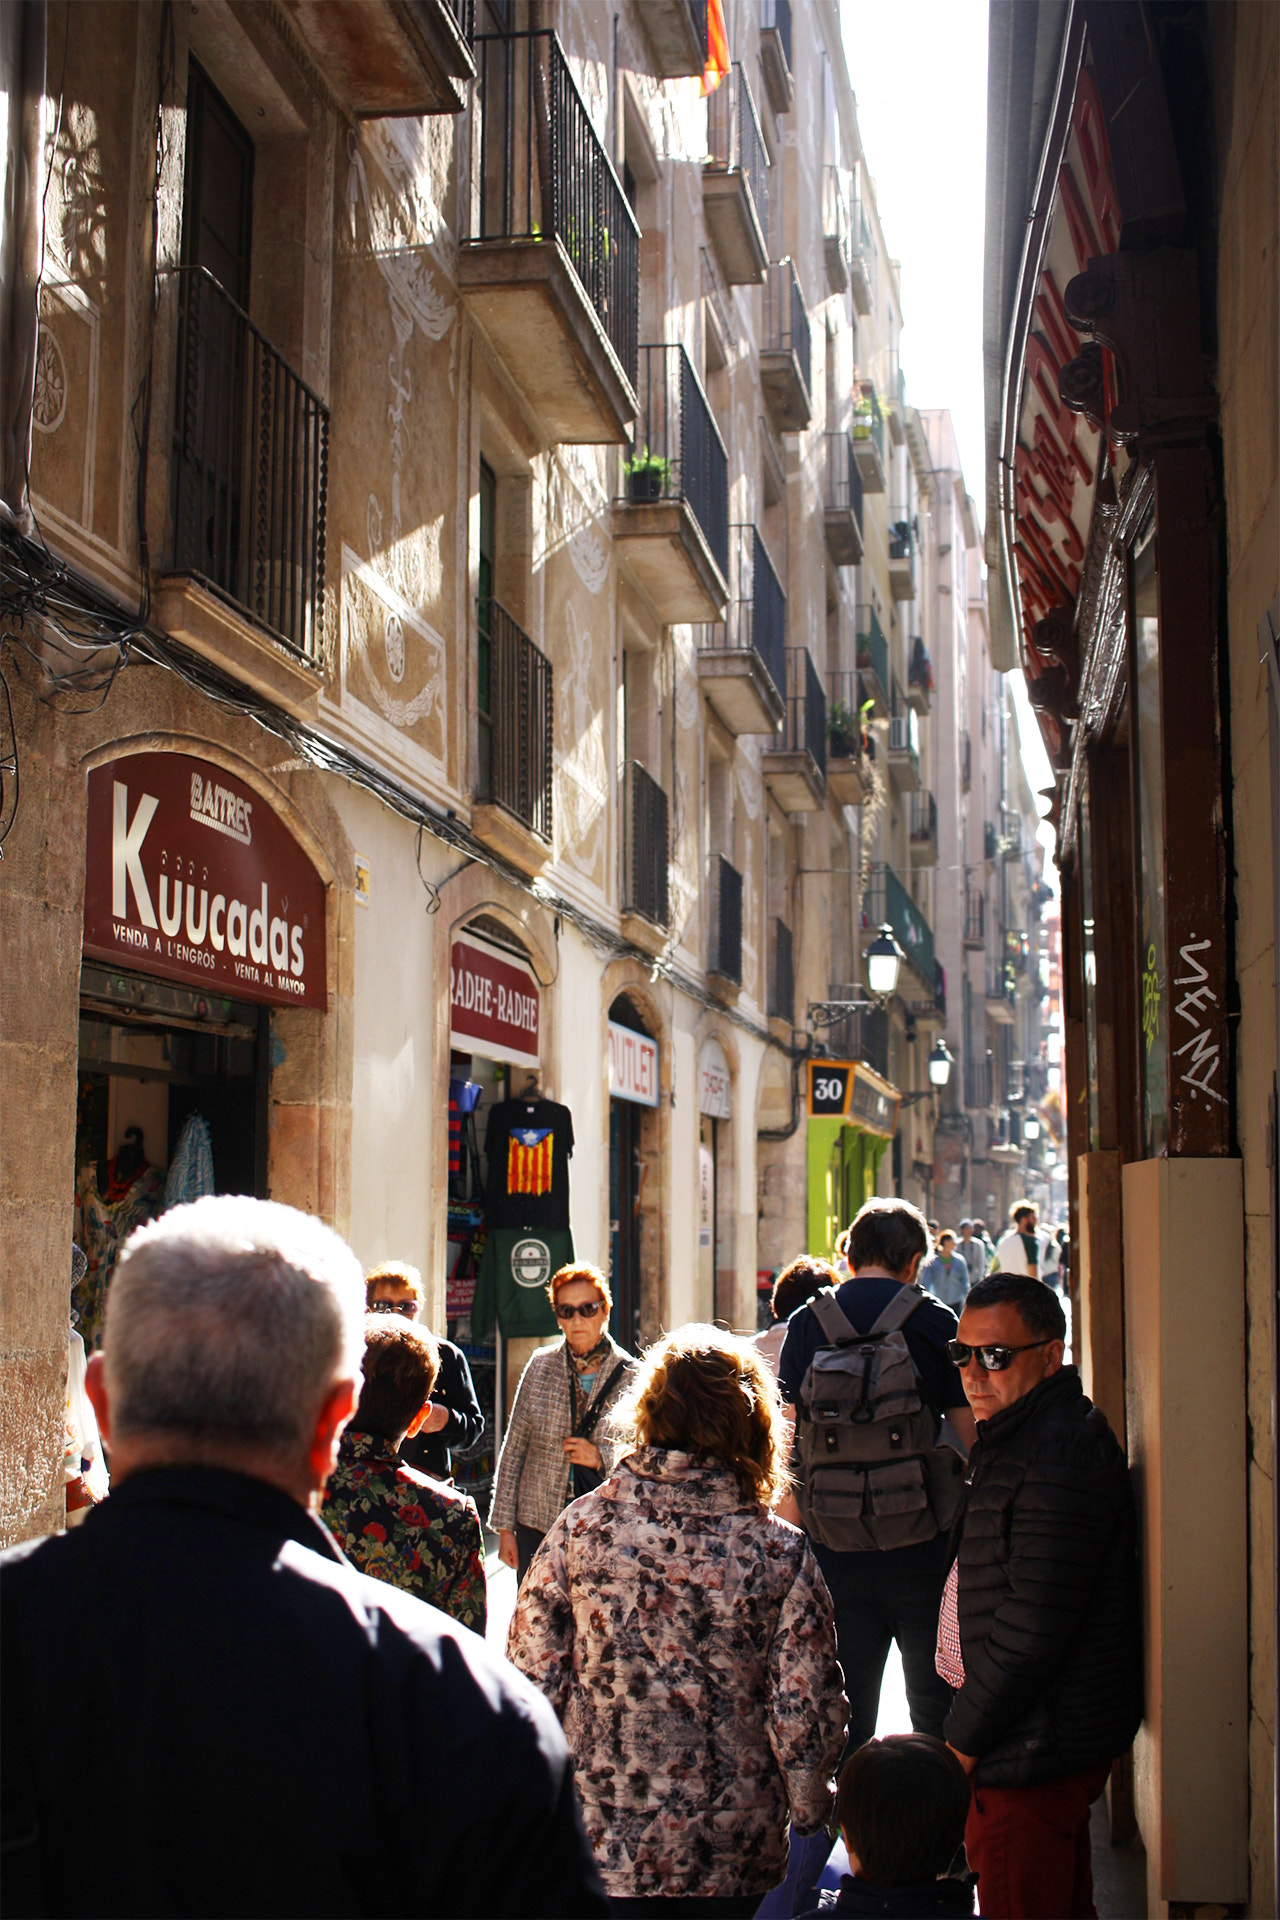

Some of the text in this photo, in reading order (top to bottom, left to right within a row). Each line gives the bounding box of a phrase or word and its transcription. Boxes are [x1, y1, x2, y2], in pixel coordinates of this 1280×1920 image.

[112, 922, 149, 950] VENDA
[154, 937, 162, 954] A
[234, 961, 261, 983] VENTA
[264, 972, 275, 988] AL
[278, 975, 306, 997] MAYOR
[815, 1078, 843, 1100] 30
